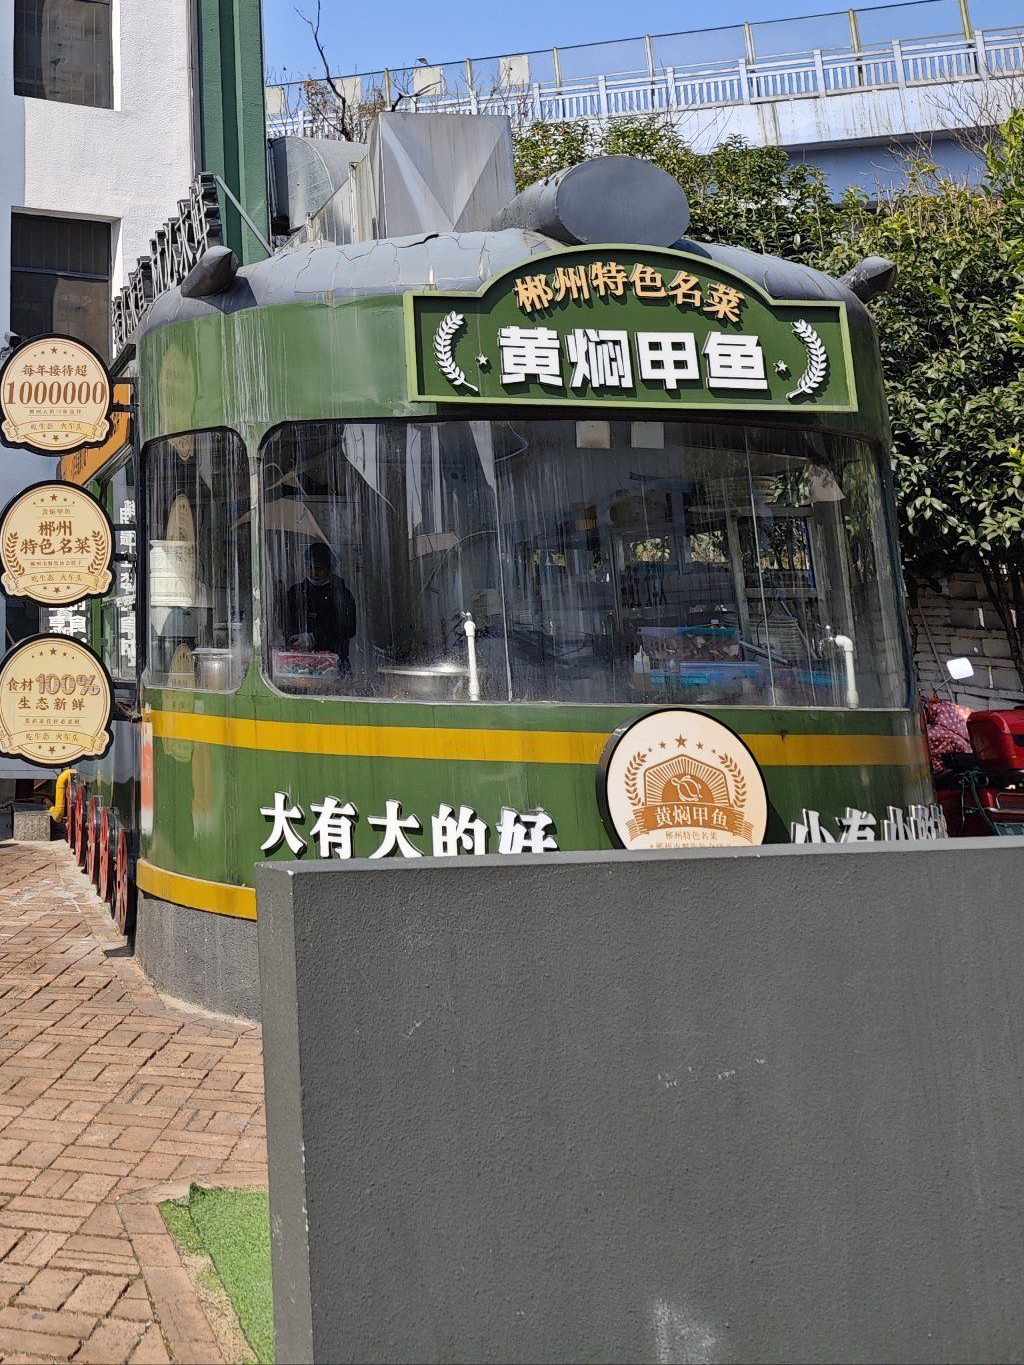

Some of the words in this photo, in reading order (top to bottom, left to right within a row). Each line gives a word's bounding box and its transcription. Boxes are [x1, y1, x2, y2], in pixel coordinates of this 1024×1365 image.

[514, 261, 746, 323] 郴州特色名菜
[498, 325, 769, 391] 黄焖甲鱼
[21, 364, 88, 377] 每年接待超
[4, 381, 106, 405] 1000000
[38, 520, 73, 537] 郴州
[20, 536, 91, 555] 特色名菜
[18, 696, 86, 711] 生态新鲜
[260, 791, 559, 859] 大有大的好
[654, 805, 728, 829] 黄焖甲鱼
[666, 831, 717, 840] 郴州特色名菜
